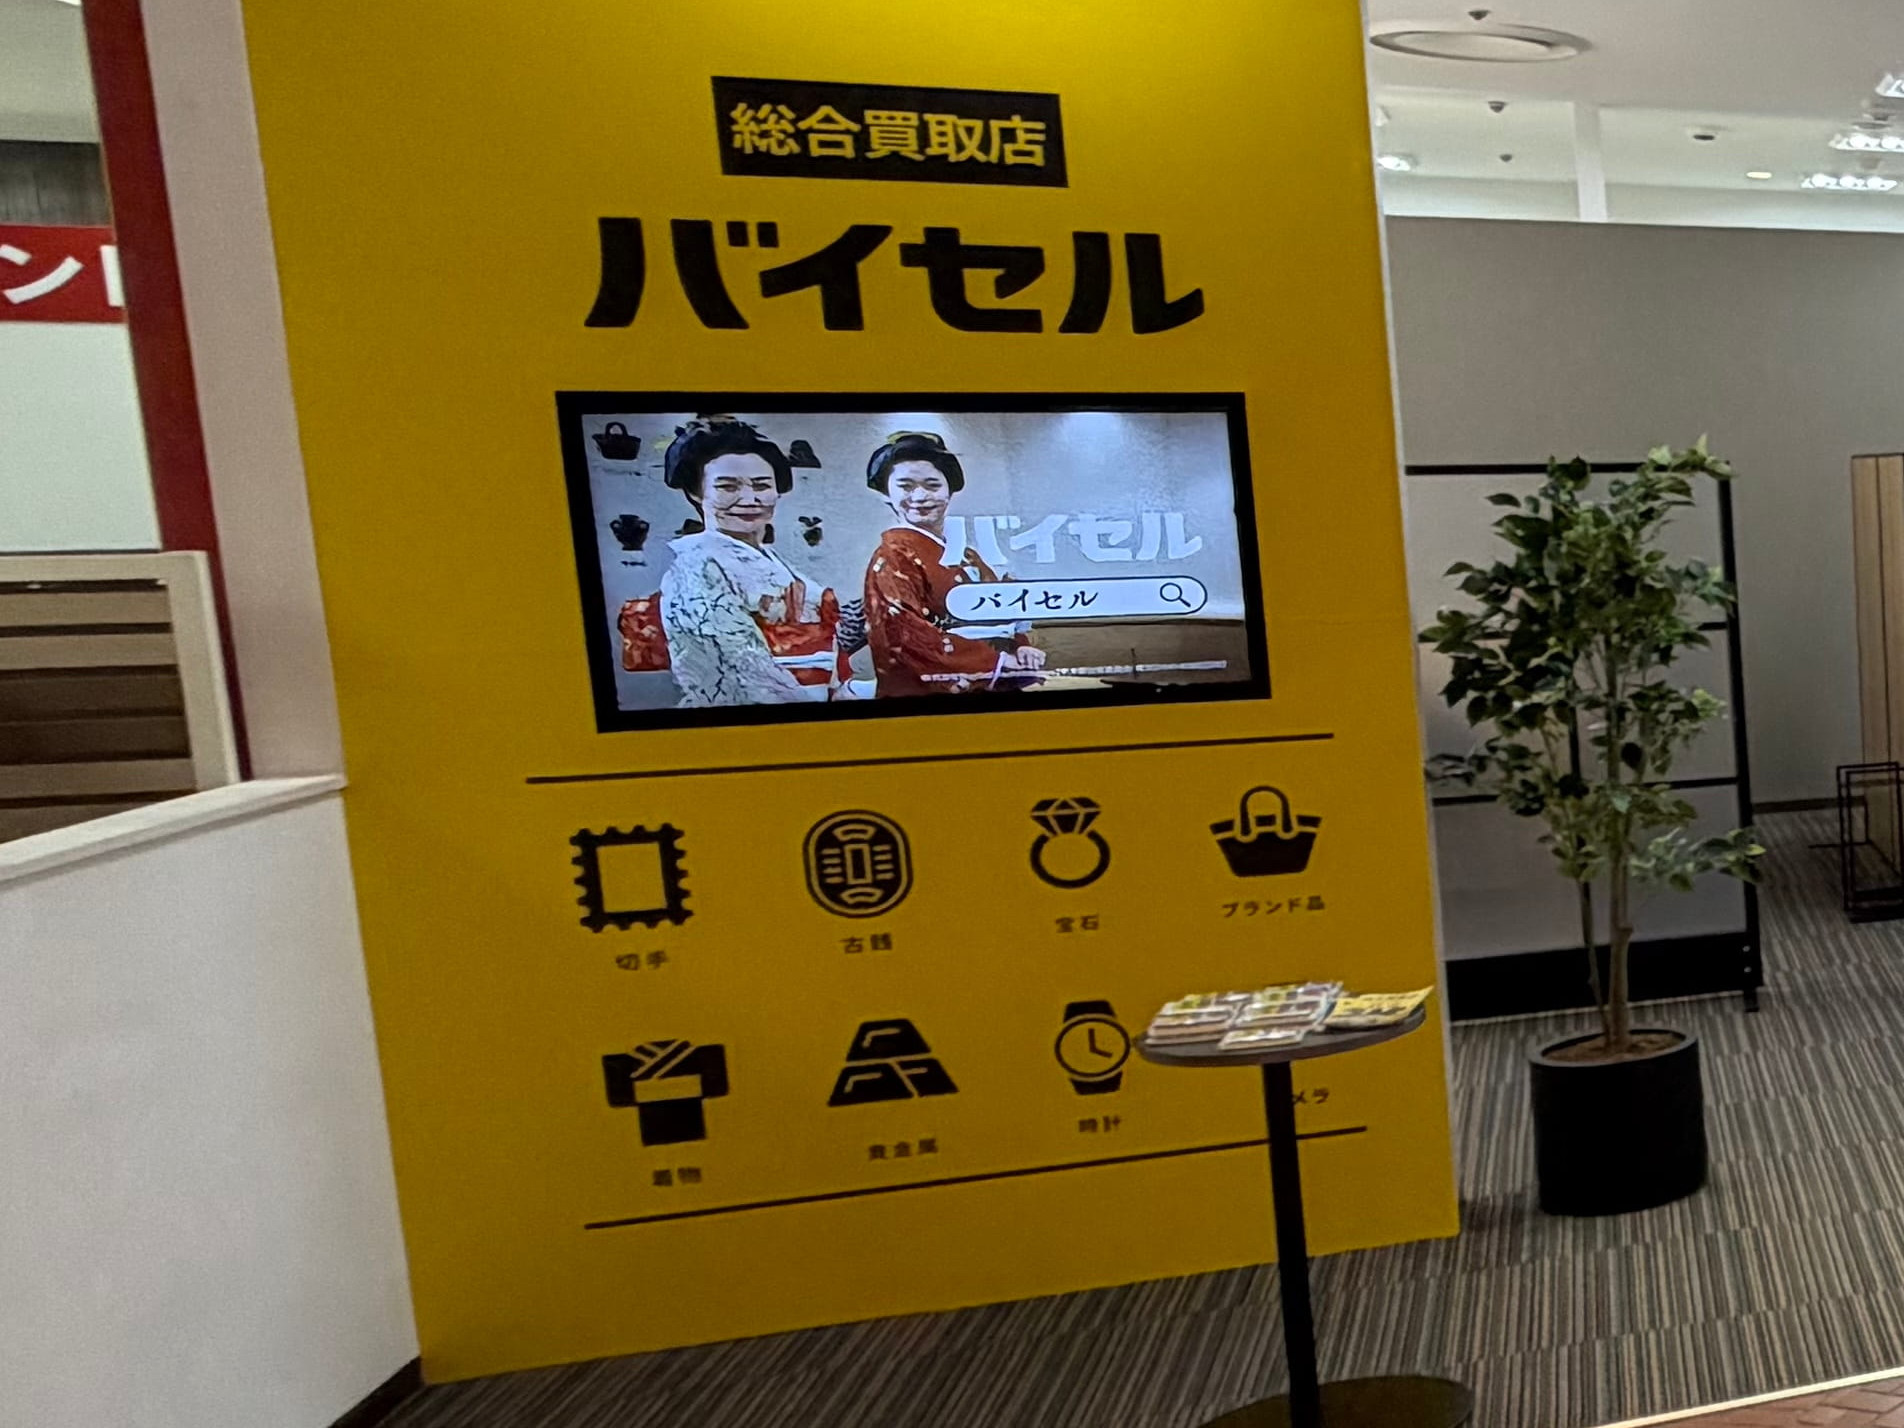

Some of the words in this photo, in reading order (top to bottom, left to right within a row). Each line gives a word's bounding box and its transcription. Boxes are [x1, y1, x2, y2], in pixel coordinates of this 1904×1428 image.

[730, 102, 1046, 167] 総合買取店
[583, 216, 1205, 335] バイセル
[938, 512, 1202, 566] バイセル
[970, 589, 1099, 611] バイセル
